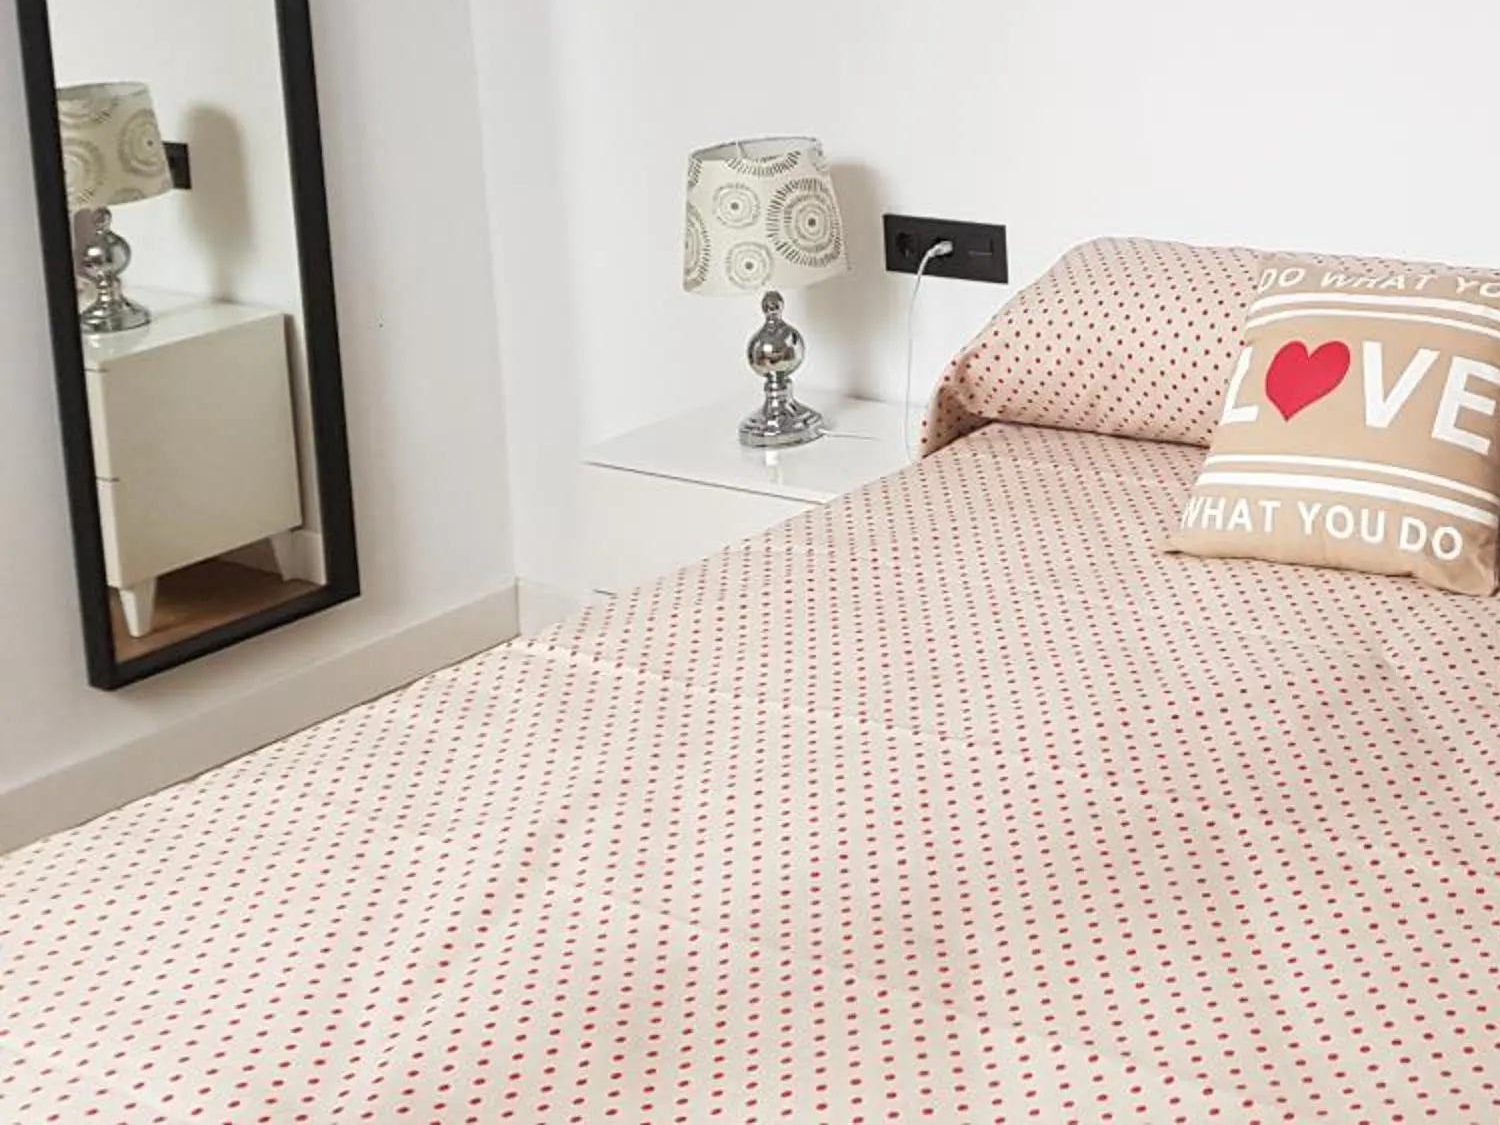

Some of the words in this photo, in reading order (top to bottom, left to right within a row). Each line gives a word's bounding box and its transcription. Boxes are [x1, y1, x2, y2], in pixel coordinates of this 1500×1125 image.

[1257, 266, 1307, 293] DO
[1321, 271, 1440, 292] WHAT
[1180, 495, 1281, 533] WHAT
[1297, 501, 1388, 543] YOU
[1400, 515, 1464, 560] DO
